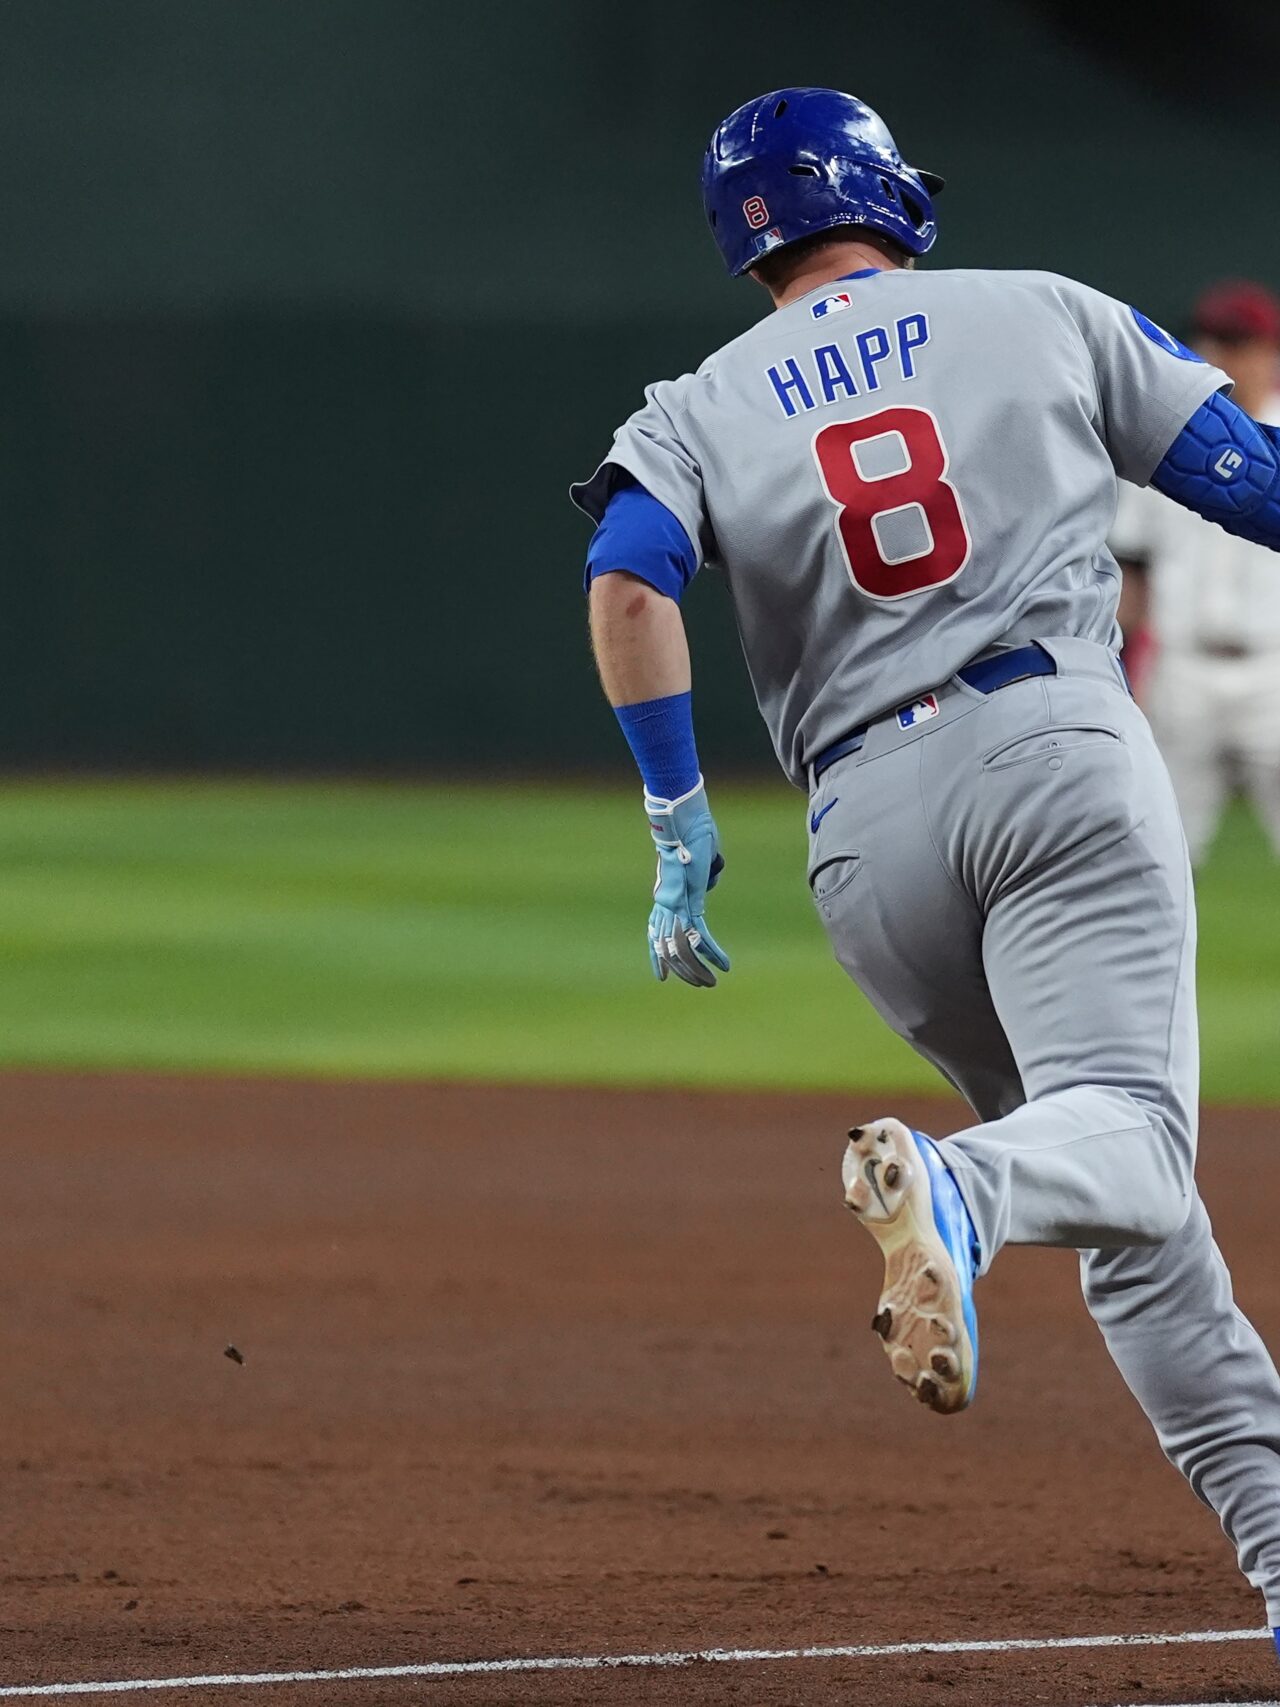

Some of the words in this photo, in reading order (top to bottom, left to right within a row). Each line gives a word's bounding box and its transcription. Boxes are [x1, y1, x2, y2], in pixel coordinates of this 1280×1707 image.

[743, 195, 770, 230] 8
[764, 312, 931, 420] HAPP
[811, 404, 972, 602] 8
